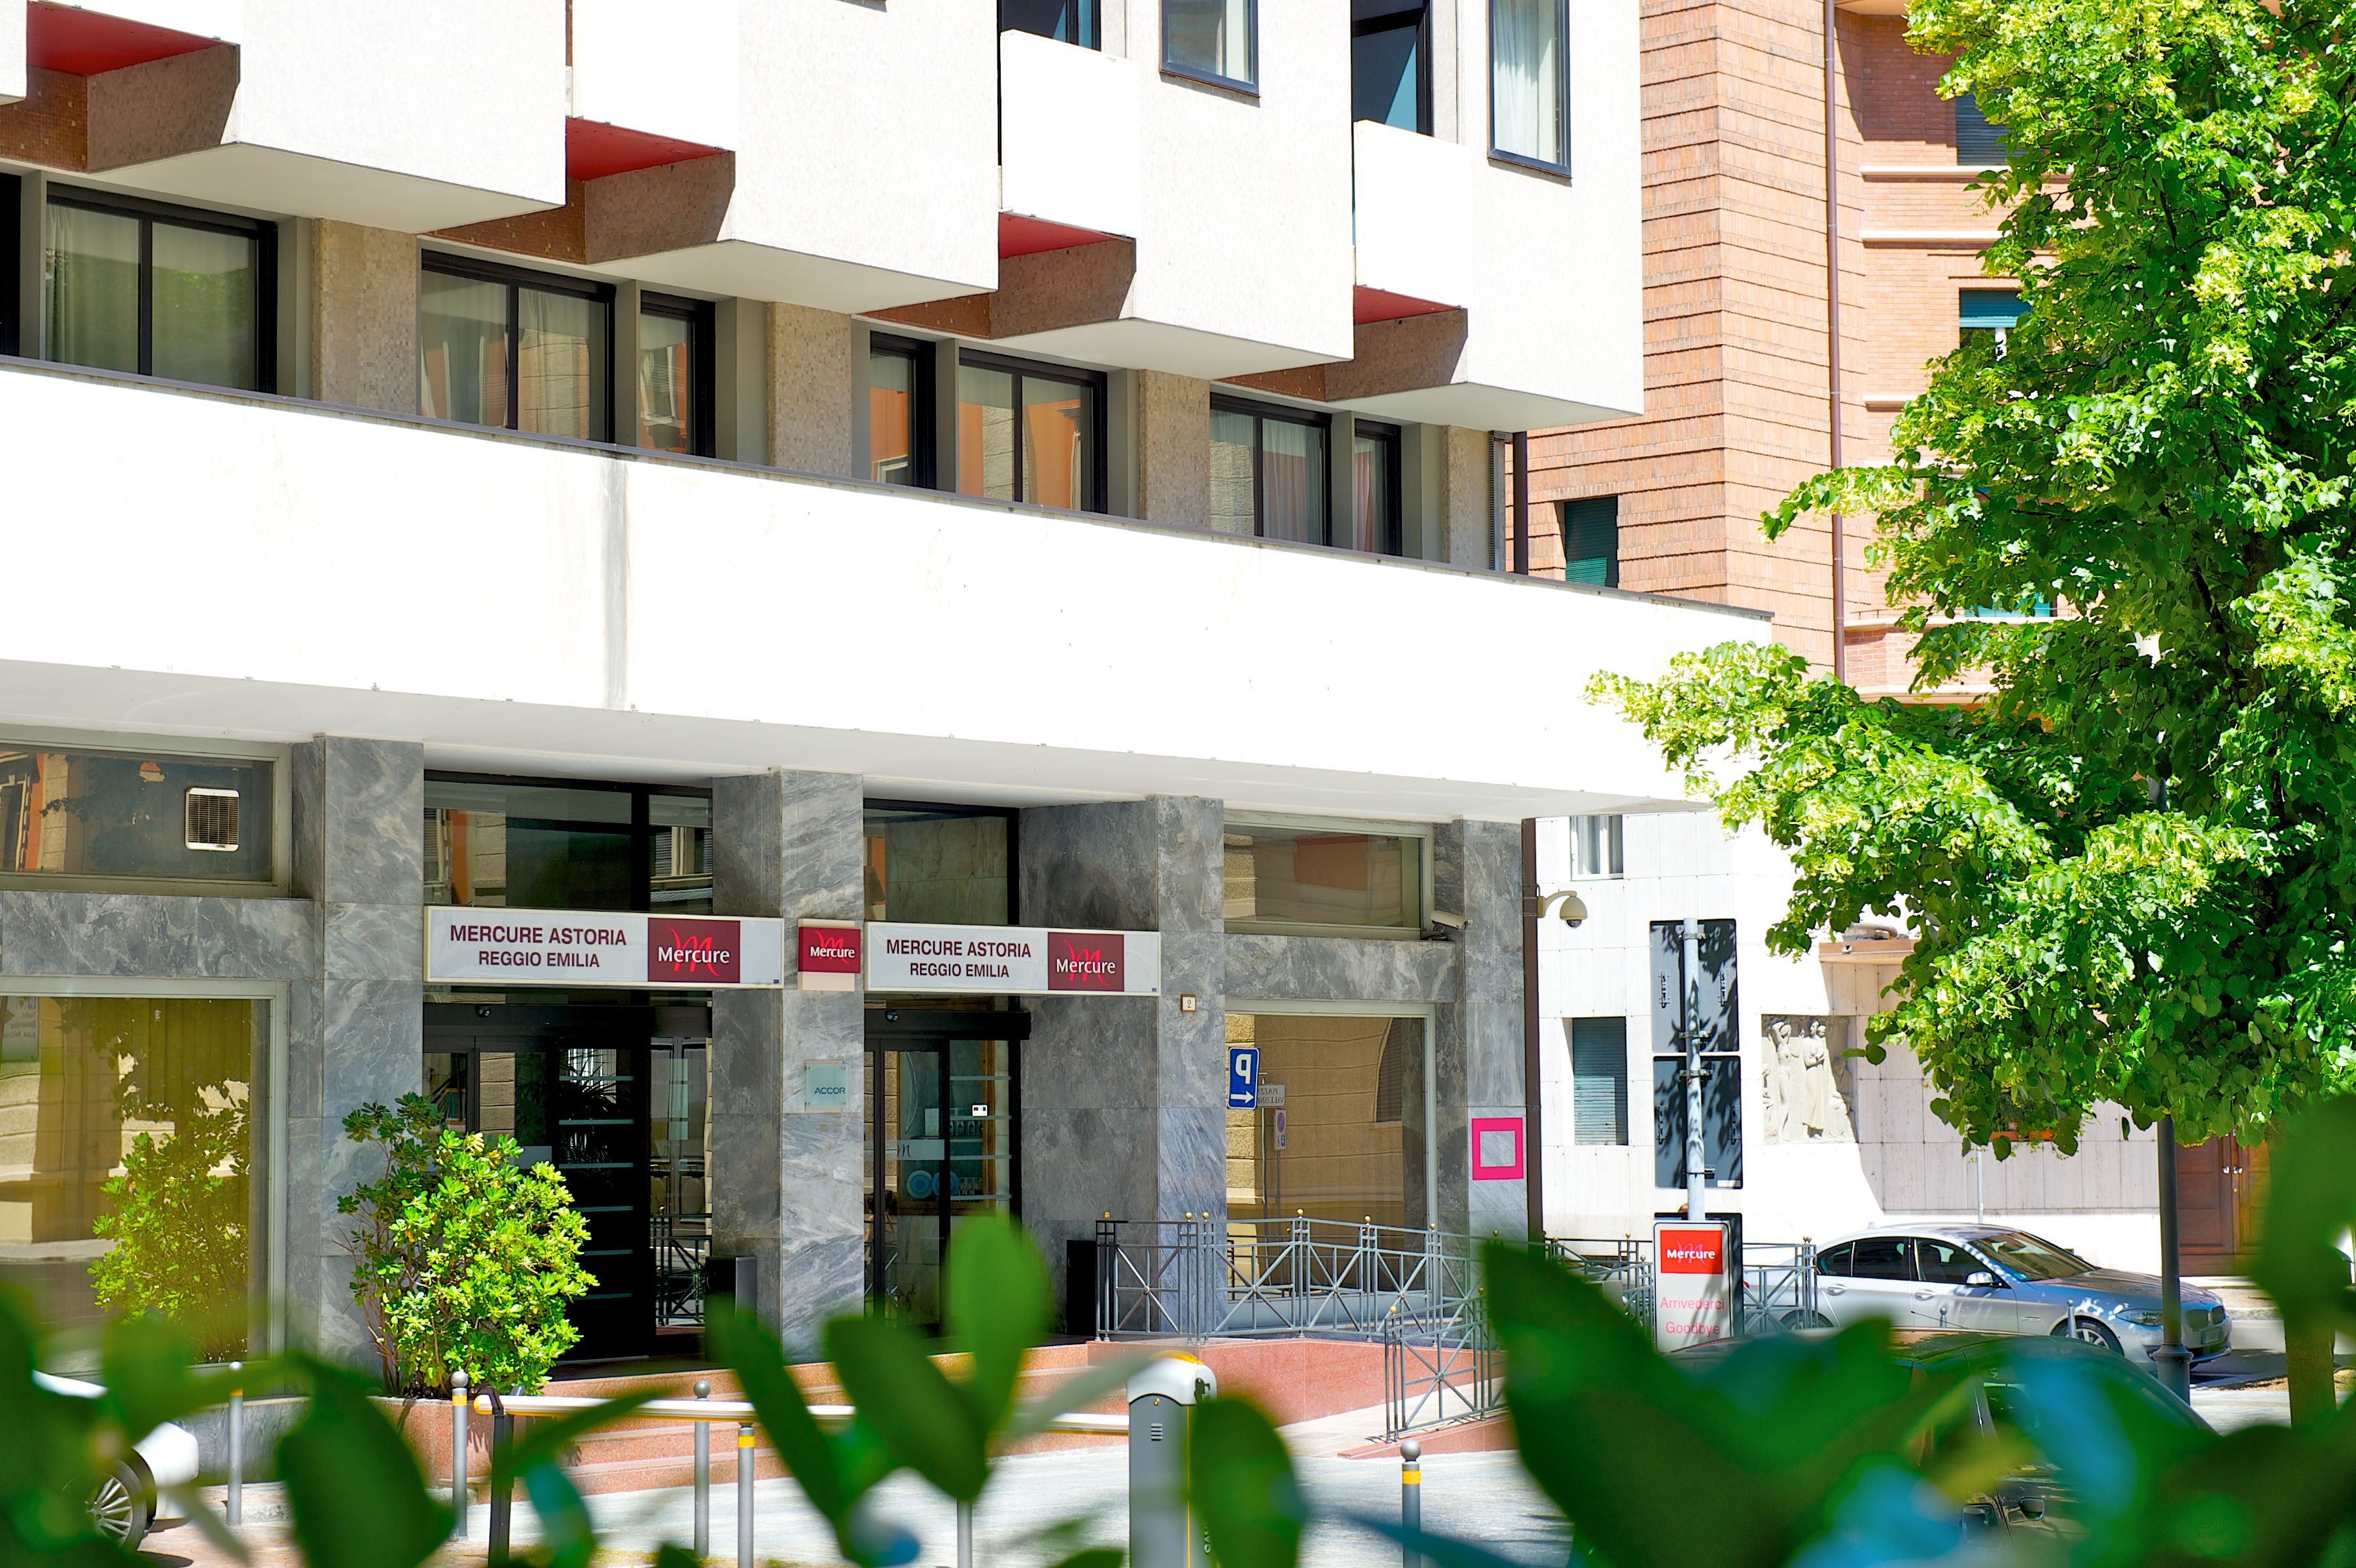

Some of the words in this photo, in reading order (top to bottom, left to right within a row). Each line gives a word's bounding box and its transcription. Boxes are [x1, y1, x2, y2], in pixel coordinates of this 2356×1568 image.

[450, 925, 543, 944] MERCURE
[548, 928, 627, 946] ASTORIA
[658, 946, 730, 964] Mercure
[810, 946, 855, 958] Mercure
[887, 939, 963, 955] MERCURE
[967, 942, 1031, 958] ASTORIA
[478, 951, 542, 967] REGGIO
[547, 953, 600, 967] EMILIA
[1056, 958, 1116, 974] Mercure
[910, 963, 961, 976] REGGIO
[966, 964, 1010, 978] EMILIA
[1187, 999, 1192, 1008] 2
[1667, 1249, 1715, 1259] Mercure
[1660, 1297, 1724, 1310] Arrivederci
[1666, 1321, 1721, 1337] Goodbye
